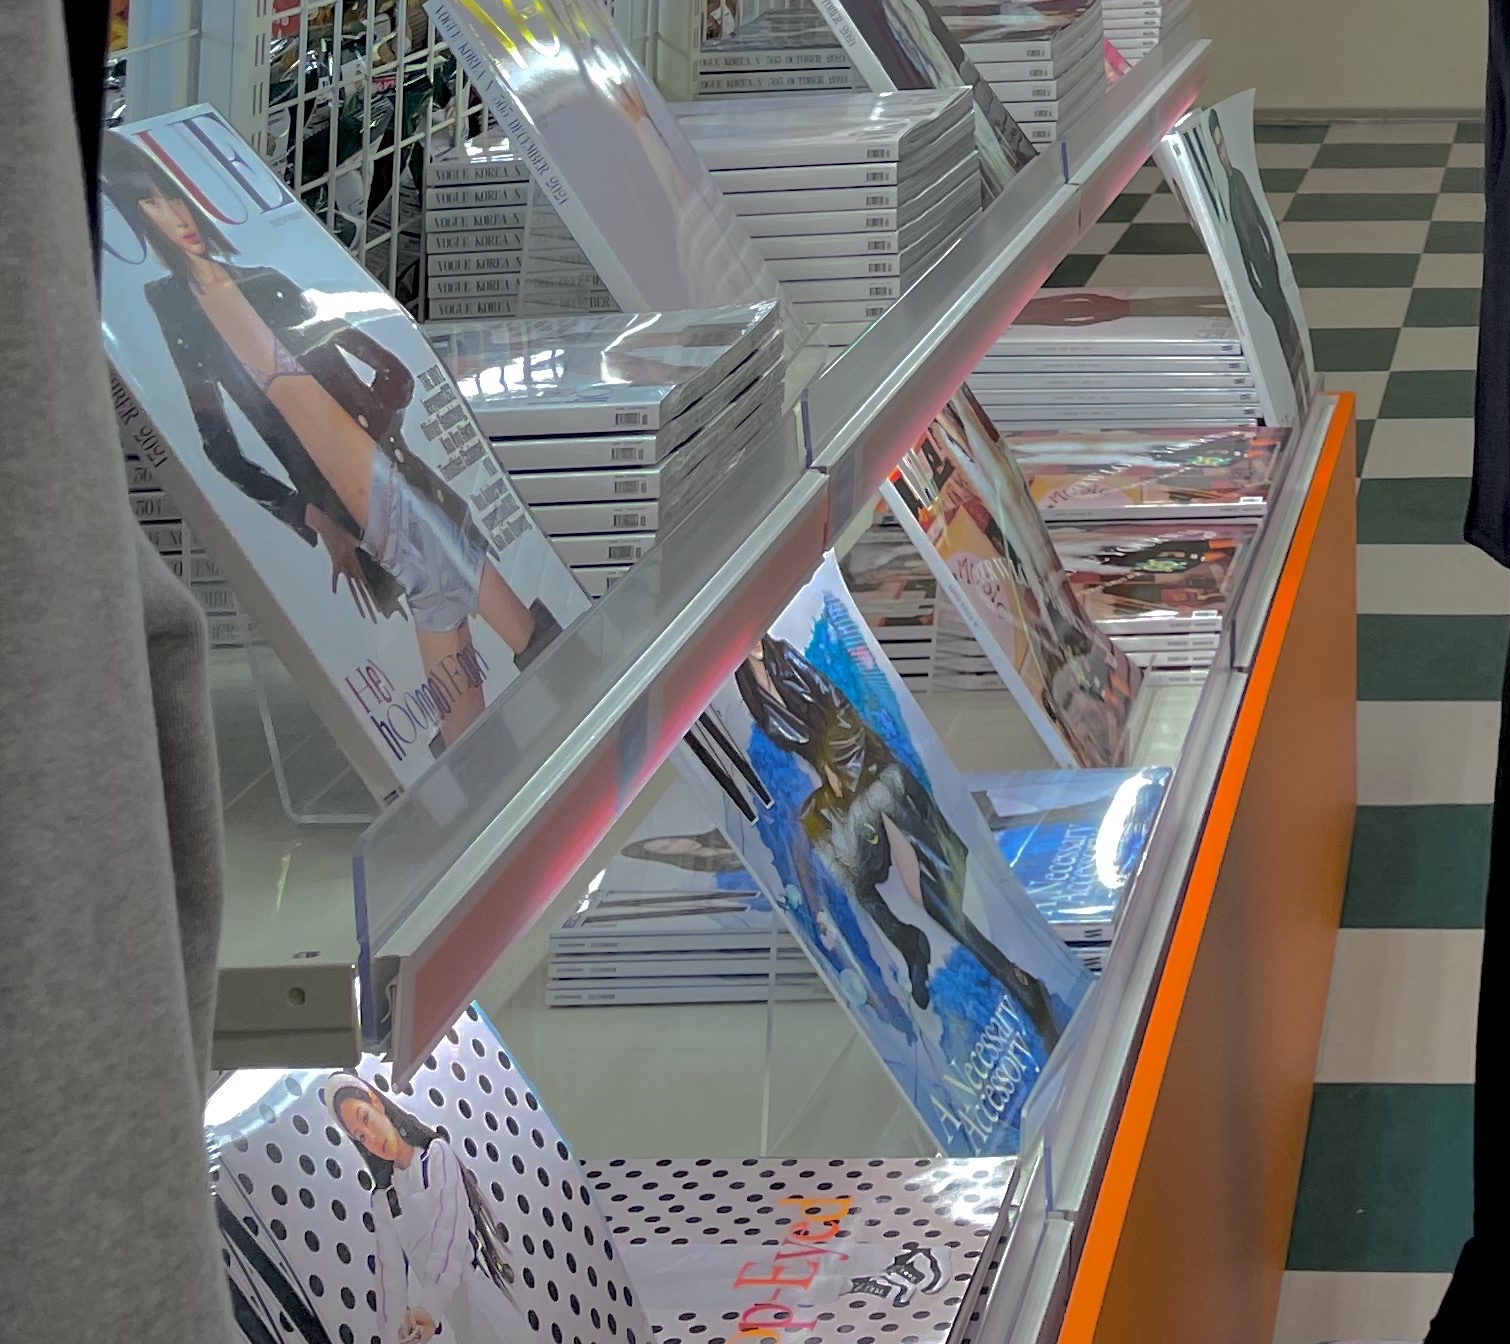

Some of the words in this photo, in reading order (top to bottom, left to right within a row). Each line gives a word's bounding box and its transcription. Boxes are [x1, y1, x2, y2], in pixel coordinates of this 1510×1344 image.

[432, 4, 462, 42] VOGUE
[456, 40, 487, 80] KOREA
[507, 117, 550, 176] DECEMBER
[544, 173, 570, 207] 2021
[436, 168, 469, 180] VOGUE
[475, 166, 509, 178] KOREA
[436, 191, 469, 204] VOGUE
[475, 189, 509, 201] KOREA
[434, 215, 469, 228] VOGUE
[474, 213, 509, 226] KOREA
[436, 235, 469, 248] VOGUE
[475, 234, 509, 247] KOREA
[438, 258, 471, 271] VOGUE
[477, 257, 510, 269] KOREA
[438, 280, 471, 293] VOGUE
[477, 279, 510, 292] KOREA
[439, 301, 473, 314] VOGUE
[477, 300, 512, 313] KOREA
[943, 995, 1028, 1097] Necessary
[957, 1030, 1040, 1157] Accessory
[930, 1094, 962, 1144] A
